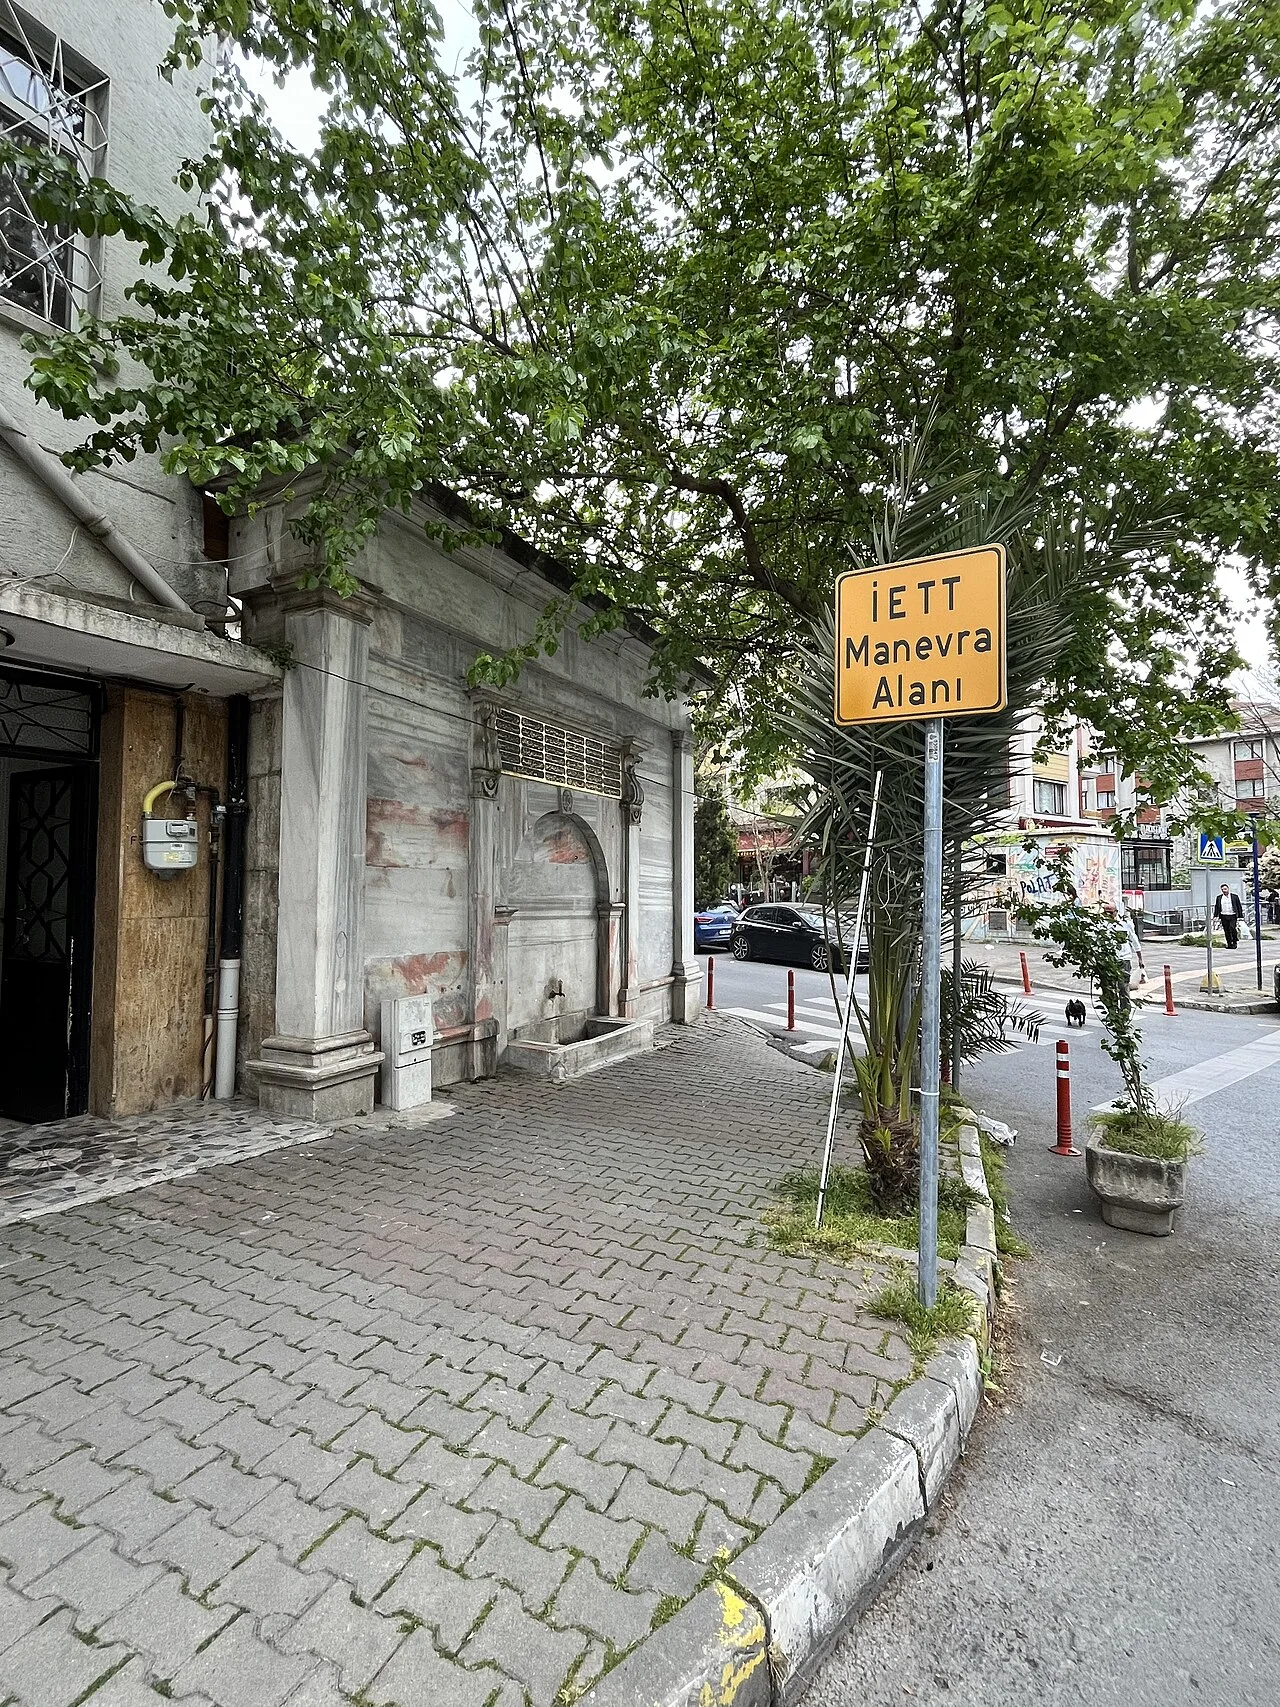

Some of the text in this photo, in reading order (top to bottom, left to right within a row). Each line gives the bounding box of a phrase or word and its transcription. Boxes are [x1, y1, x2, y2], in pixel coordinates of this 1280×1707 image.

[872, 576, 961, 622] İETT
[845, 628, 992, 669] Manevra
[872, 674, 962, 709] Alanı
